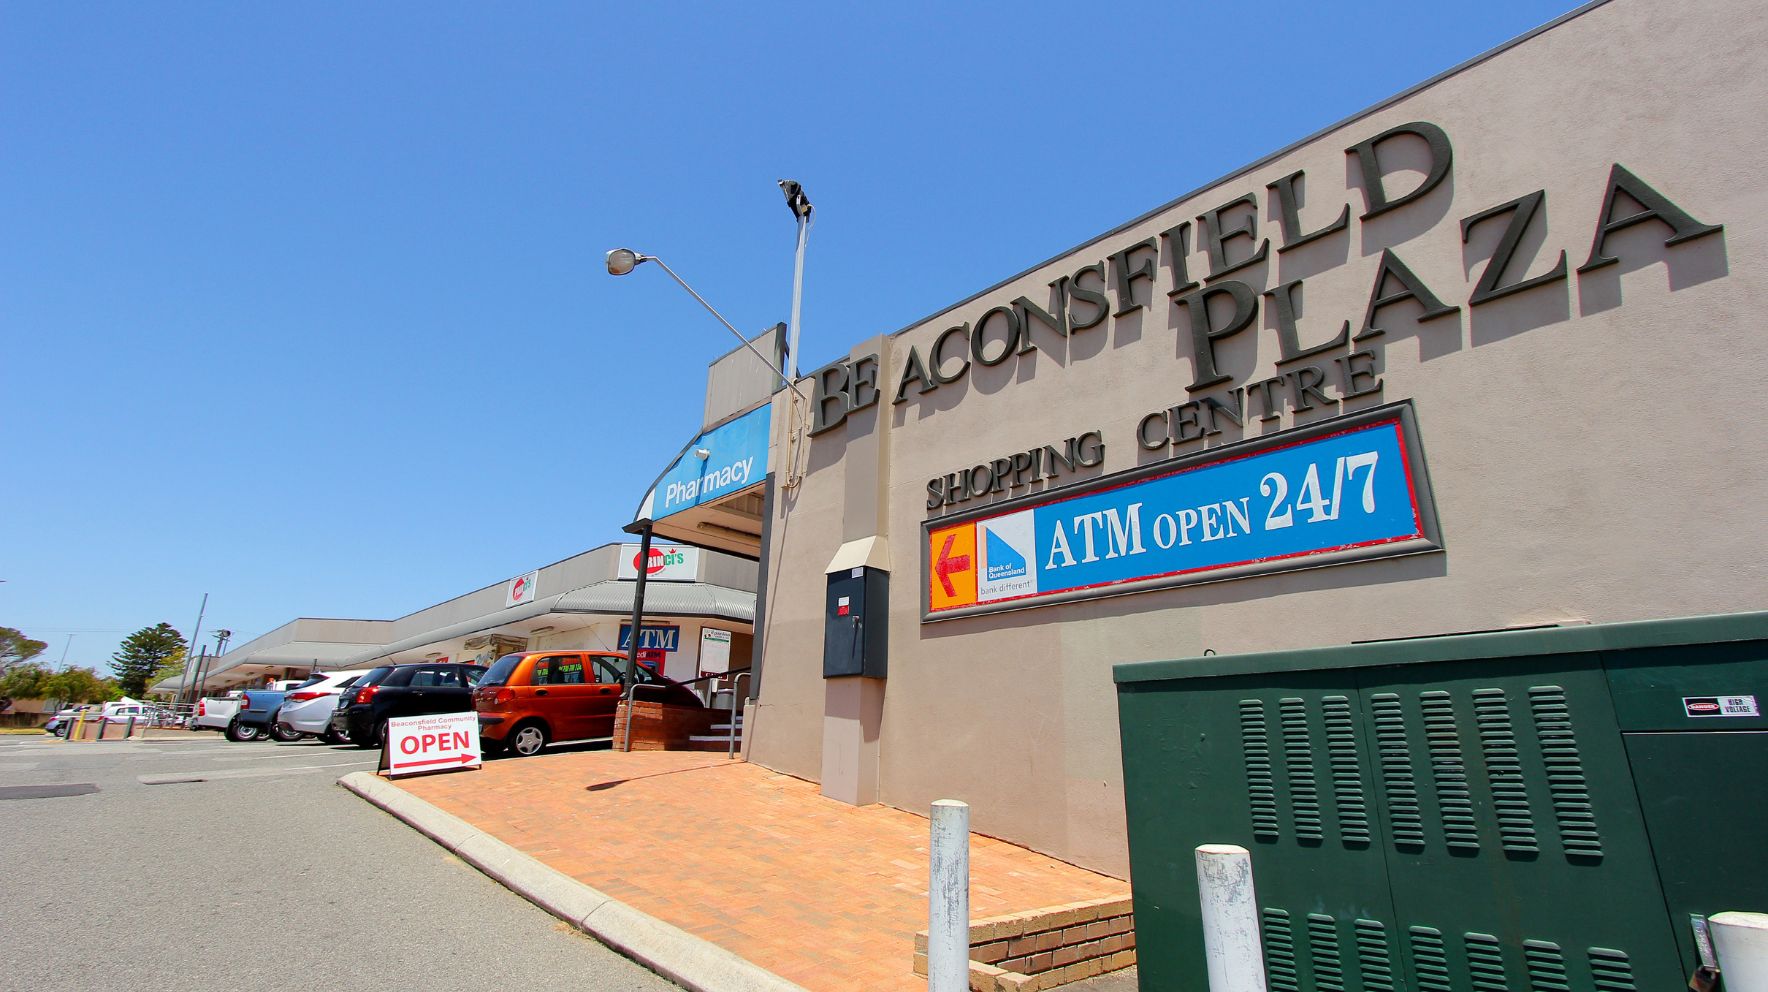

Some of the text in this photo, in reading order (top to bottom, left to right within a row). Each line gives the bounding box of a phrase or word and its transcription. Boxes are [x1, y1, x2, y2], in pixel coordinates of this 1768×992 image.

[807, 121, 1453, 438] BEACONSFIELD
[1174, 163, 1724, 393] PLAZA
[926, 350, 1384, 510] SHOPPING CENTRE
[665, 456, 753, 508] Pharmacy
[1045, 451, 1379, 570] ATM OPEN 24/7
[645, 553, 684, 568] RINCI'S
[989, 564, 1004, 572] Bank
[989, 568, 1024, 578] Queensland
[980, 581, 1030, 595] bank different
[391, 715, 476, 728] Beaconsfield Community
[400, 731, 469, 754] OPEN
